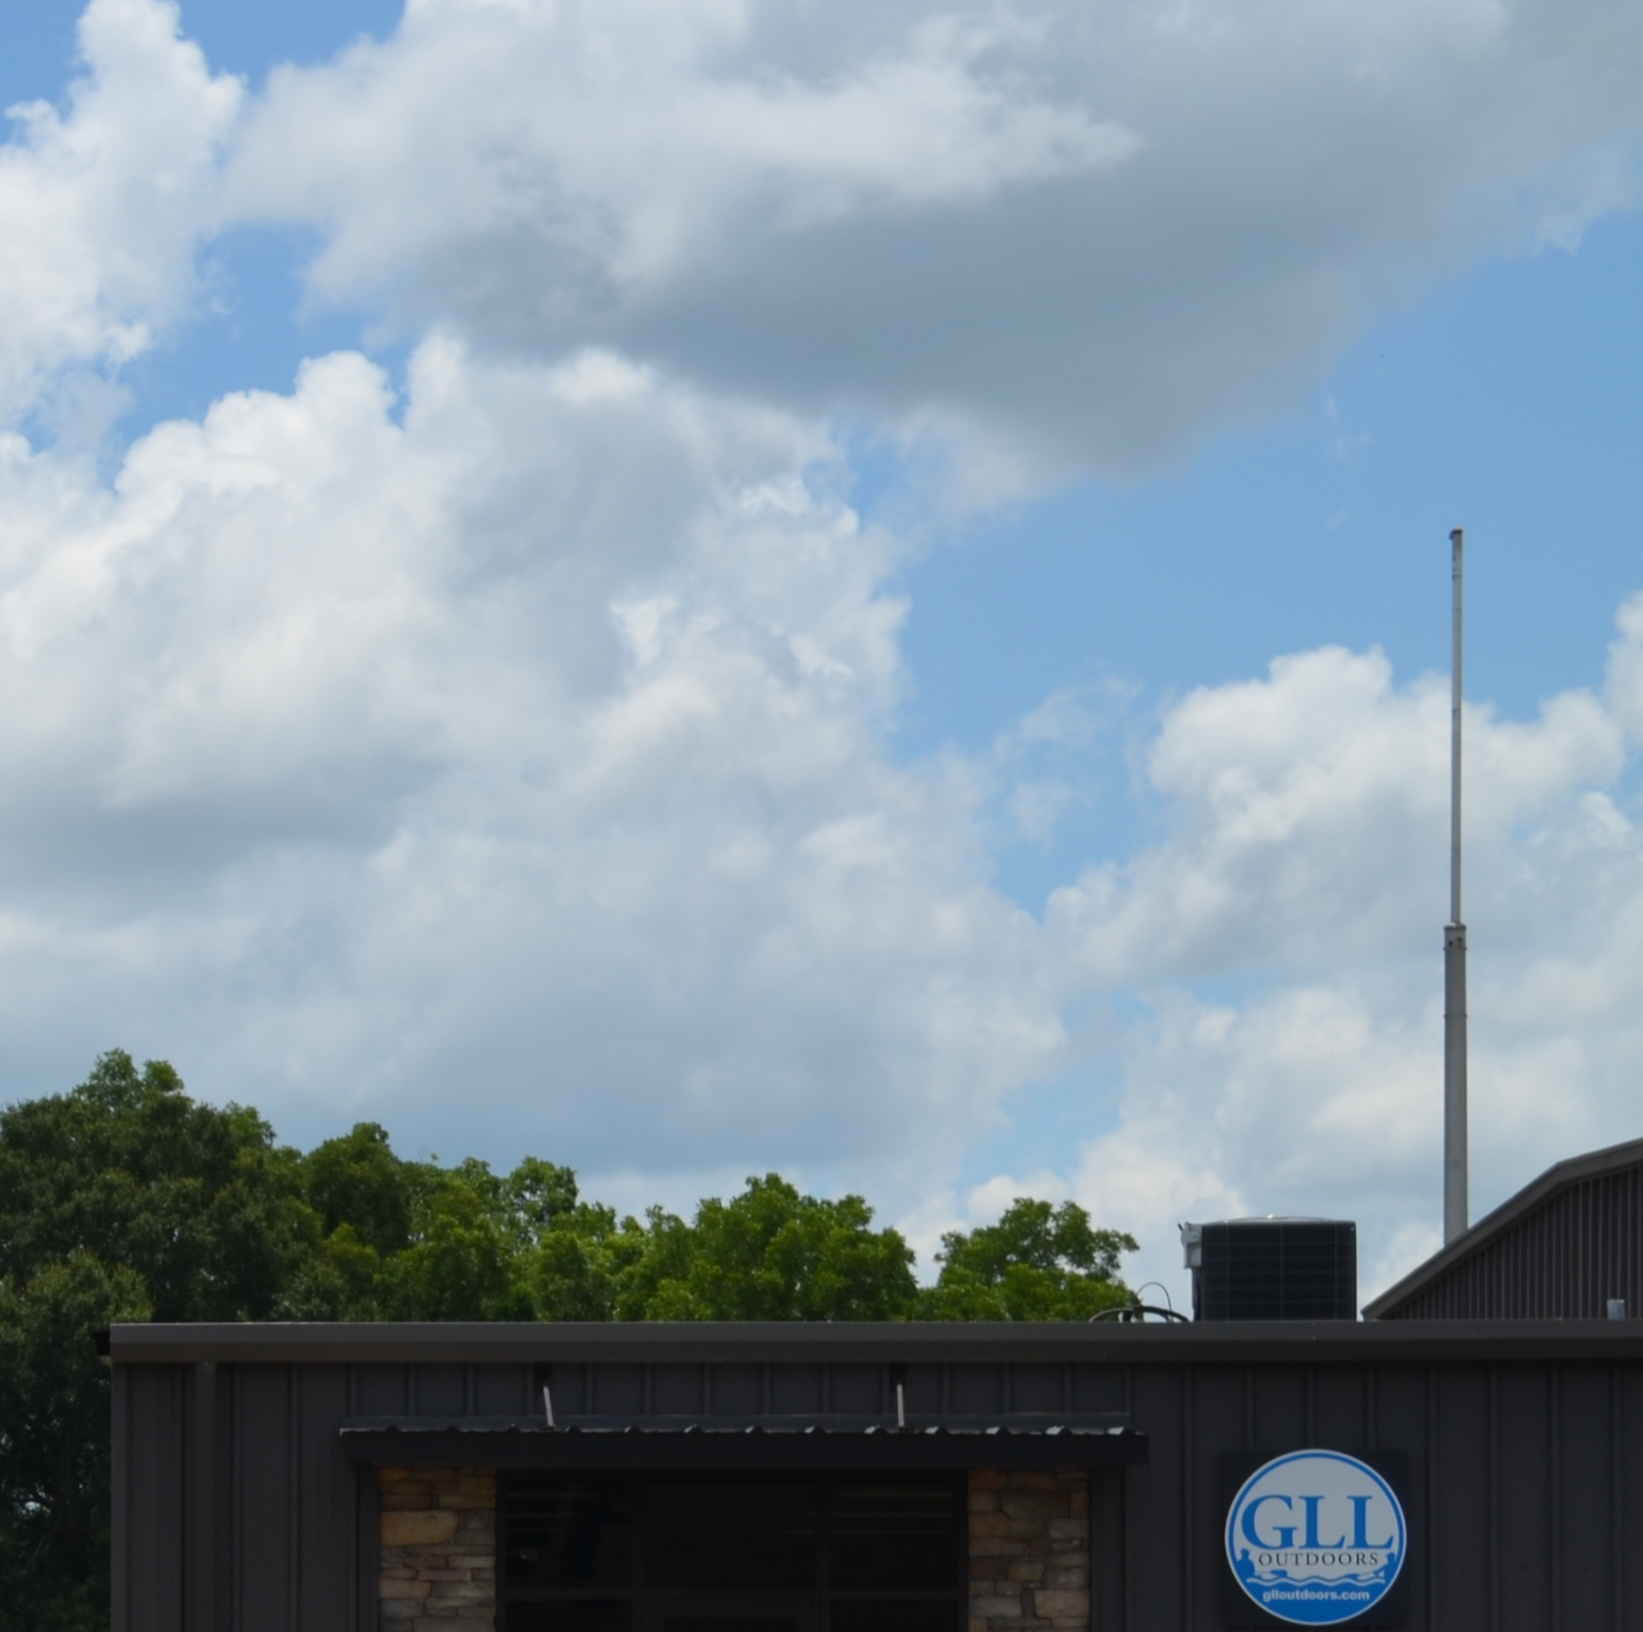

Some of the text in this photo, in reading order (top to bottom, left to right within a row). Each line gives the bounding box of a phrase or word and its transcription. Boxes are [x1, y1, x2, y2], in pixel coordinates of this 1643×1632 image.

[1241, 1494, 1394, 1550] GLL
[1258, 1552, 1379, 1566] OUTDOORS
[1262, 1588, 1370, 1602] glloutdoors.com
